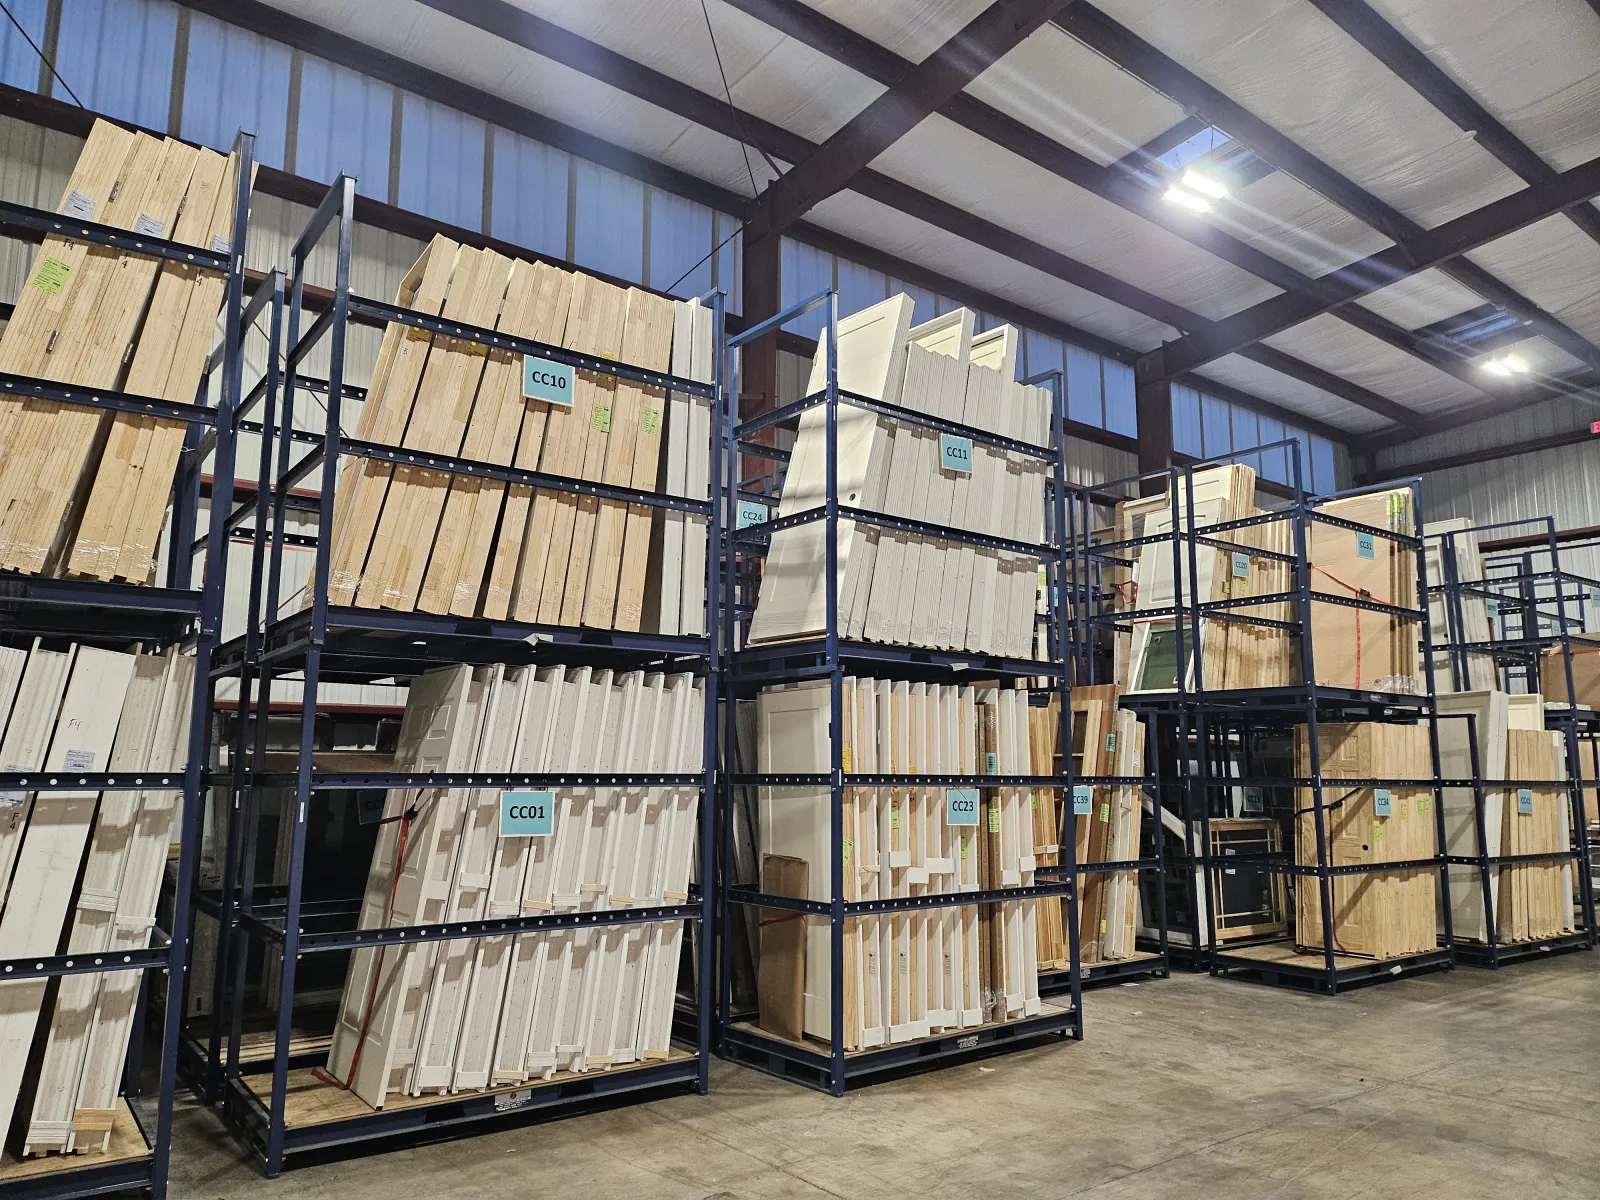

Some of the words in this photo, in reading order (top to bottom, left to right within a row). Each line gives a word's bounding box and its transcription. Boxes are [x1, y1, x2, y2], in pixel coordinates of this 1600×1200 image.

[532, 371, 566, 389] CC10
[946, 446, 968, 460] CC11
[742, 510, 763, 522] CC24
[509, 805, 545, 819] CC01
[952, 800, 974, 812] CC23
